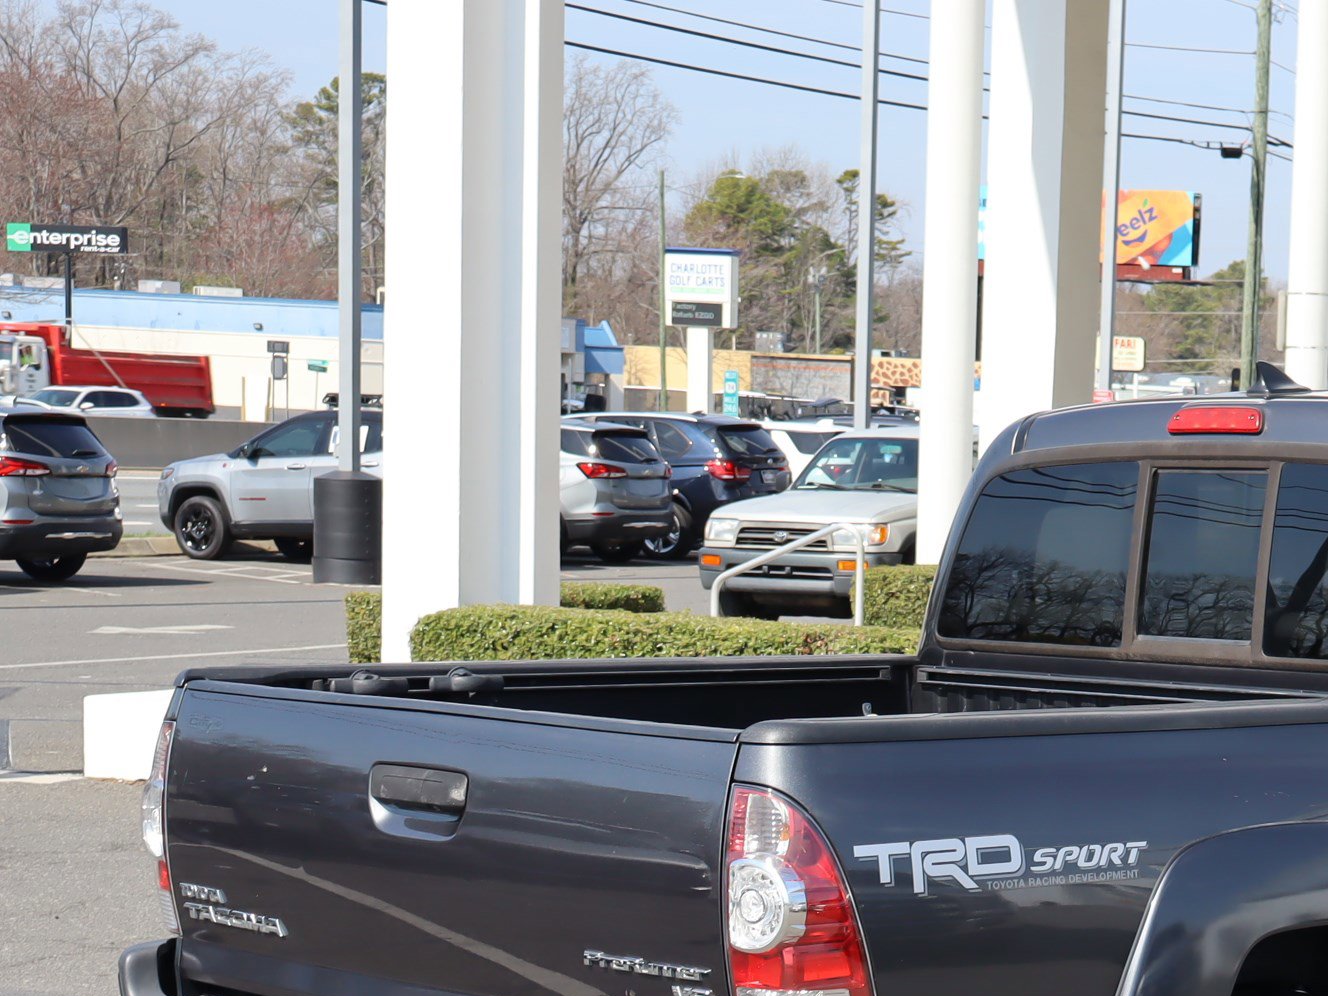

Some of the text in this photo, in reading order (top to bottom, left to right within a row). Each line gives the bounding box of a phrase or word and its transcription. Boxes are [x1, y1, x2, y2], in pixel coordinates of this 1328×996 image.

[12, 230, 120, 249] enterprise
[670, 262, 725, 276] CHARLOTTE
[669, 274, 726, 288] GOLF CARTS
[1113, 339, 1137, 348] FARI
[853, 834, 1148, 897] TRD SPORT
[986, 869, 1140, 891] TOYOTA RACING DEVELOPMENT
[183, 901, 289, 938] TACOMA
